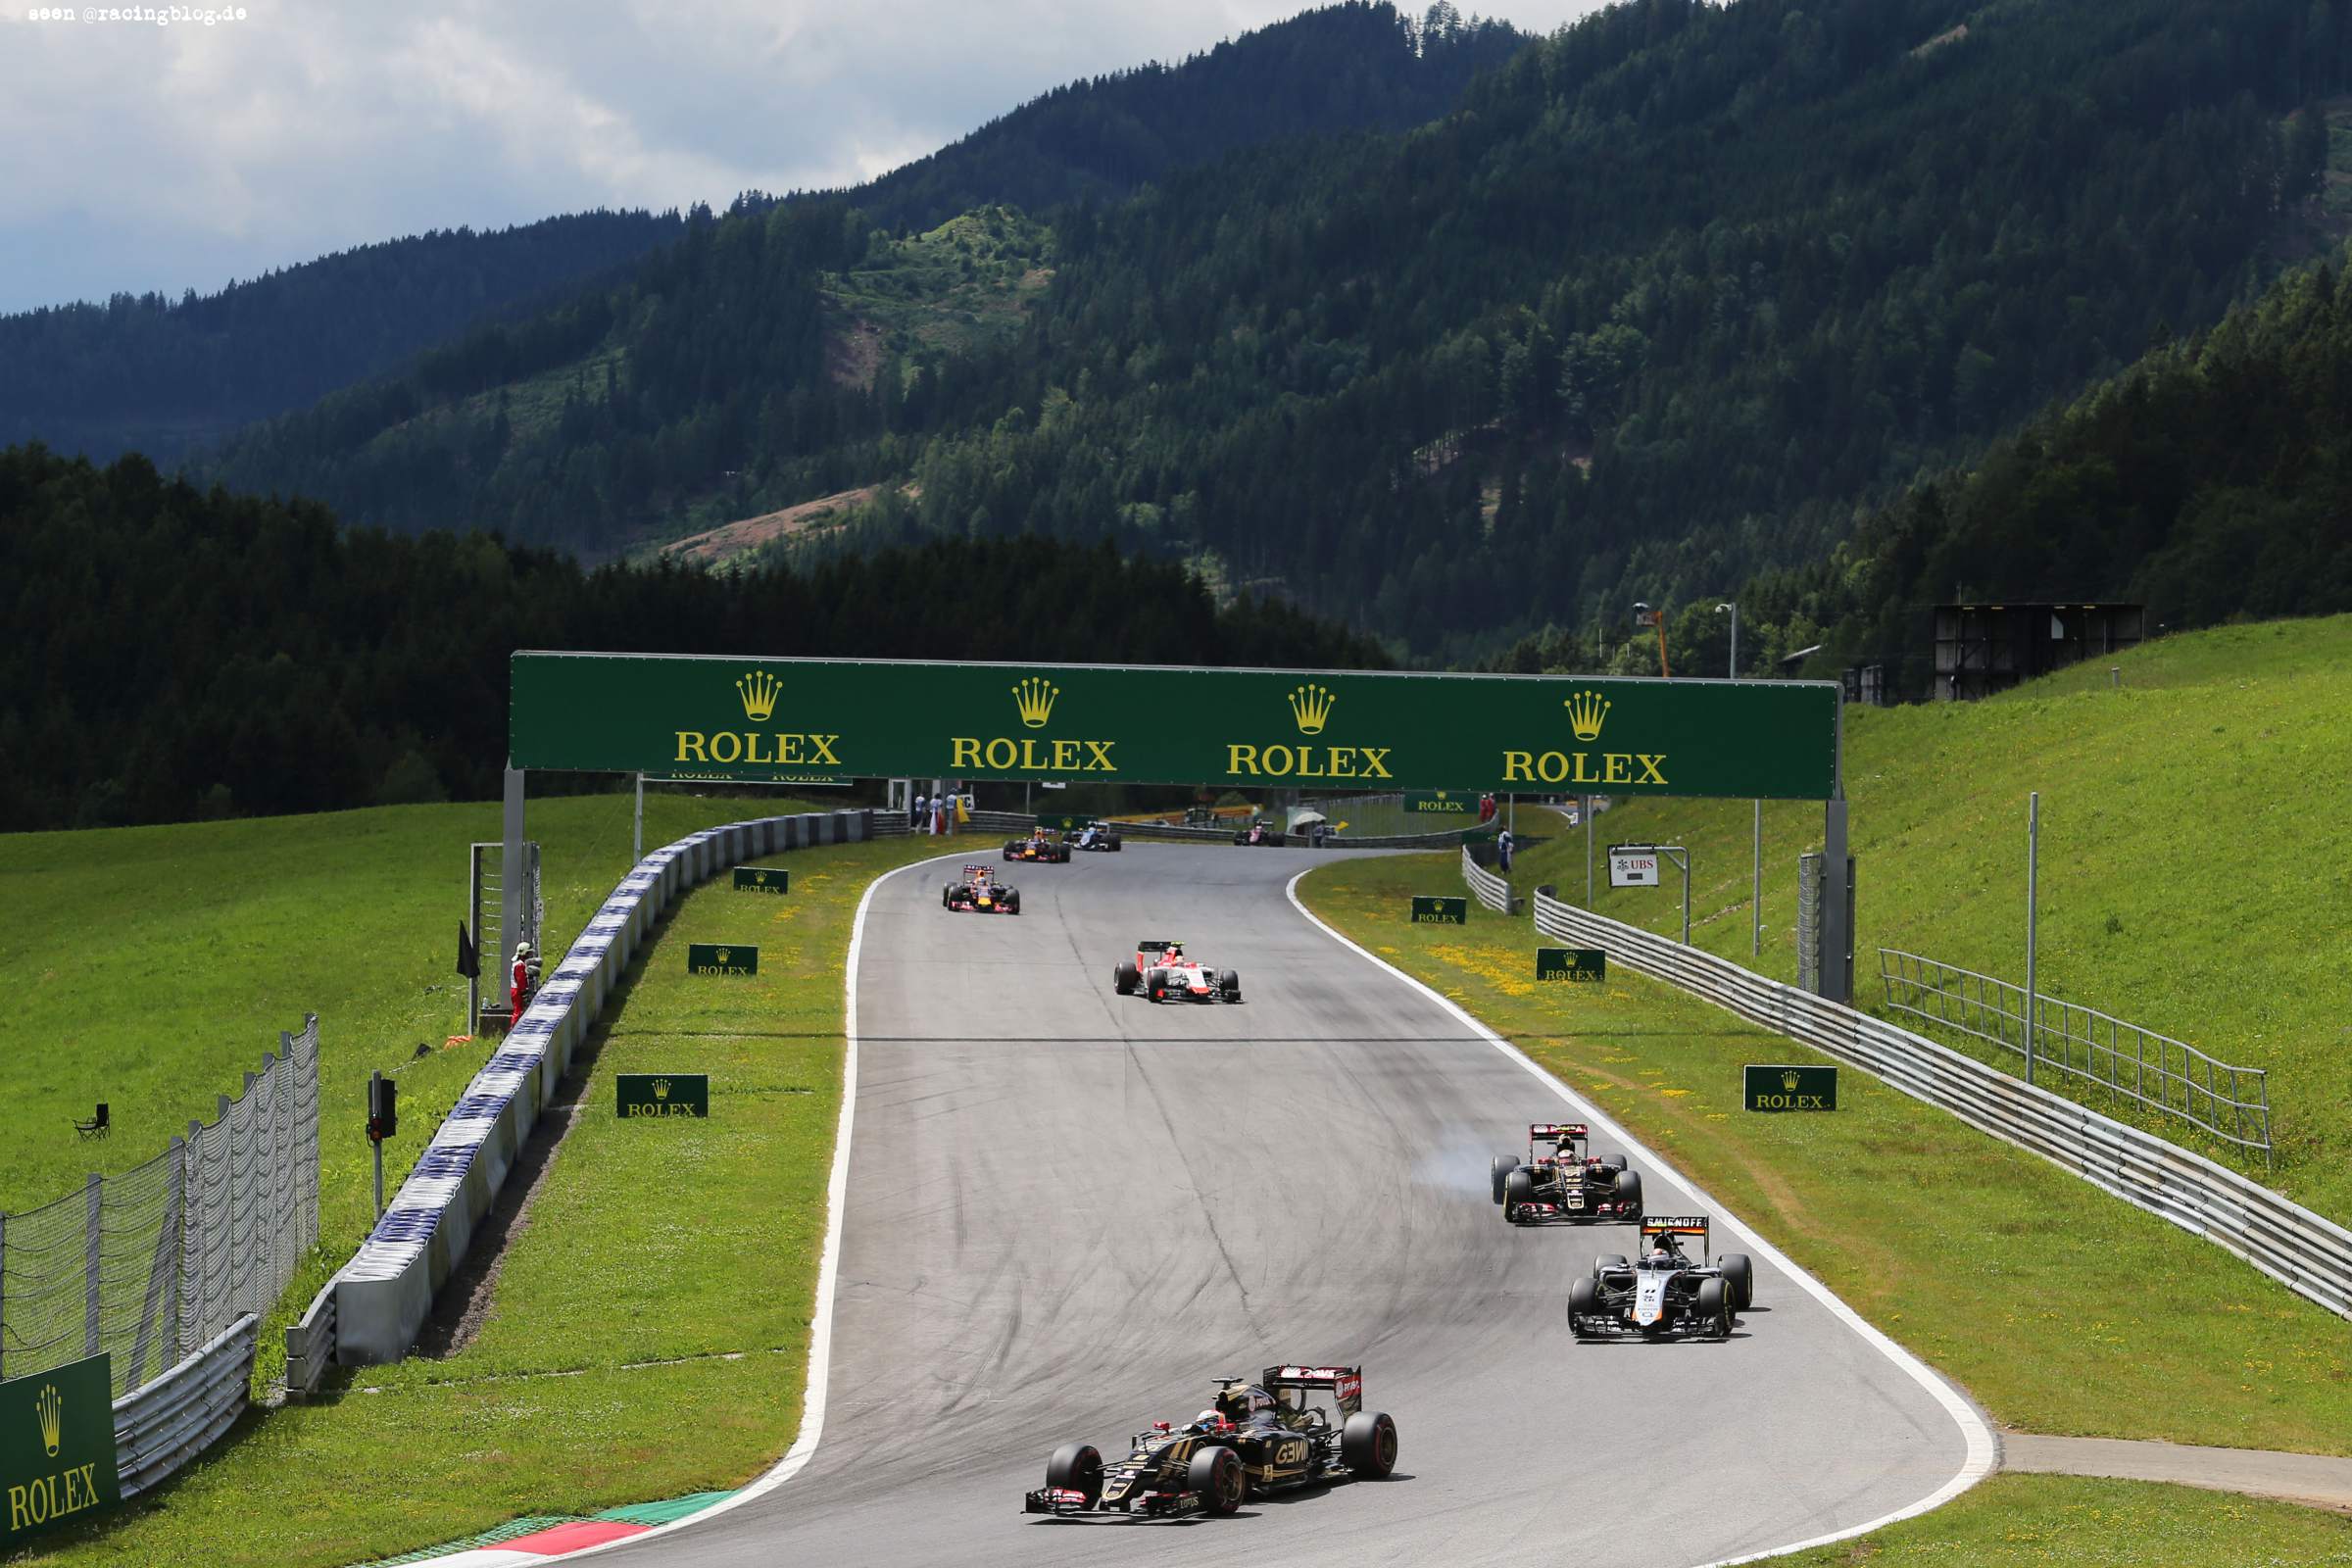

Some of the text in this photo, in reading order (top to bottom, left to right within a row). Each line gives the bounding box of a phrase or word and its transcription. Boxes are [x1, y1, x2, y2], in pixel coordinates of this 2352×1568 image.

[674, 731, 841, 764] ROLEX
[951, 737, 1117, 771] ROLEX
[1226, 744, 1394, 778] ROLEX
[1501, 751, 1669, 785] ROLEX
[1418, 800, 1464, 811] ROLEX
[1631, 859, 1654, 870] UBS
[739, 885, 781, 894] ROLEX
[1418, 913, 1459, 924] ROLEX
[698, 965, 748, 976] ROLEX
[1544, 969, 1595, 981] ROLEX
[1756, 1094, 1824, 1109] ROLEX
[626, 1102, 696, 1118] ROLEX
[8, 1462, 99, 1531] ROLEX
